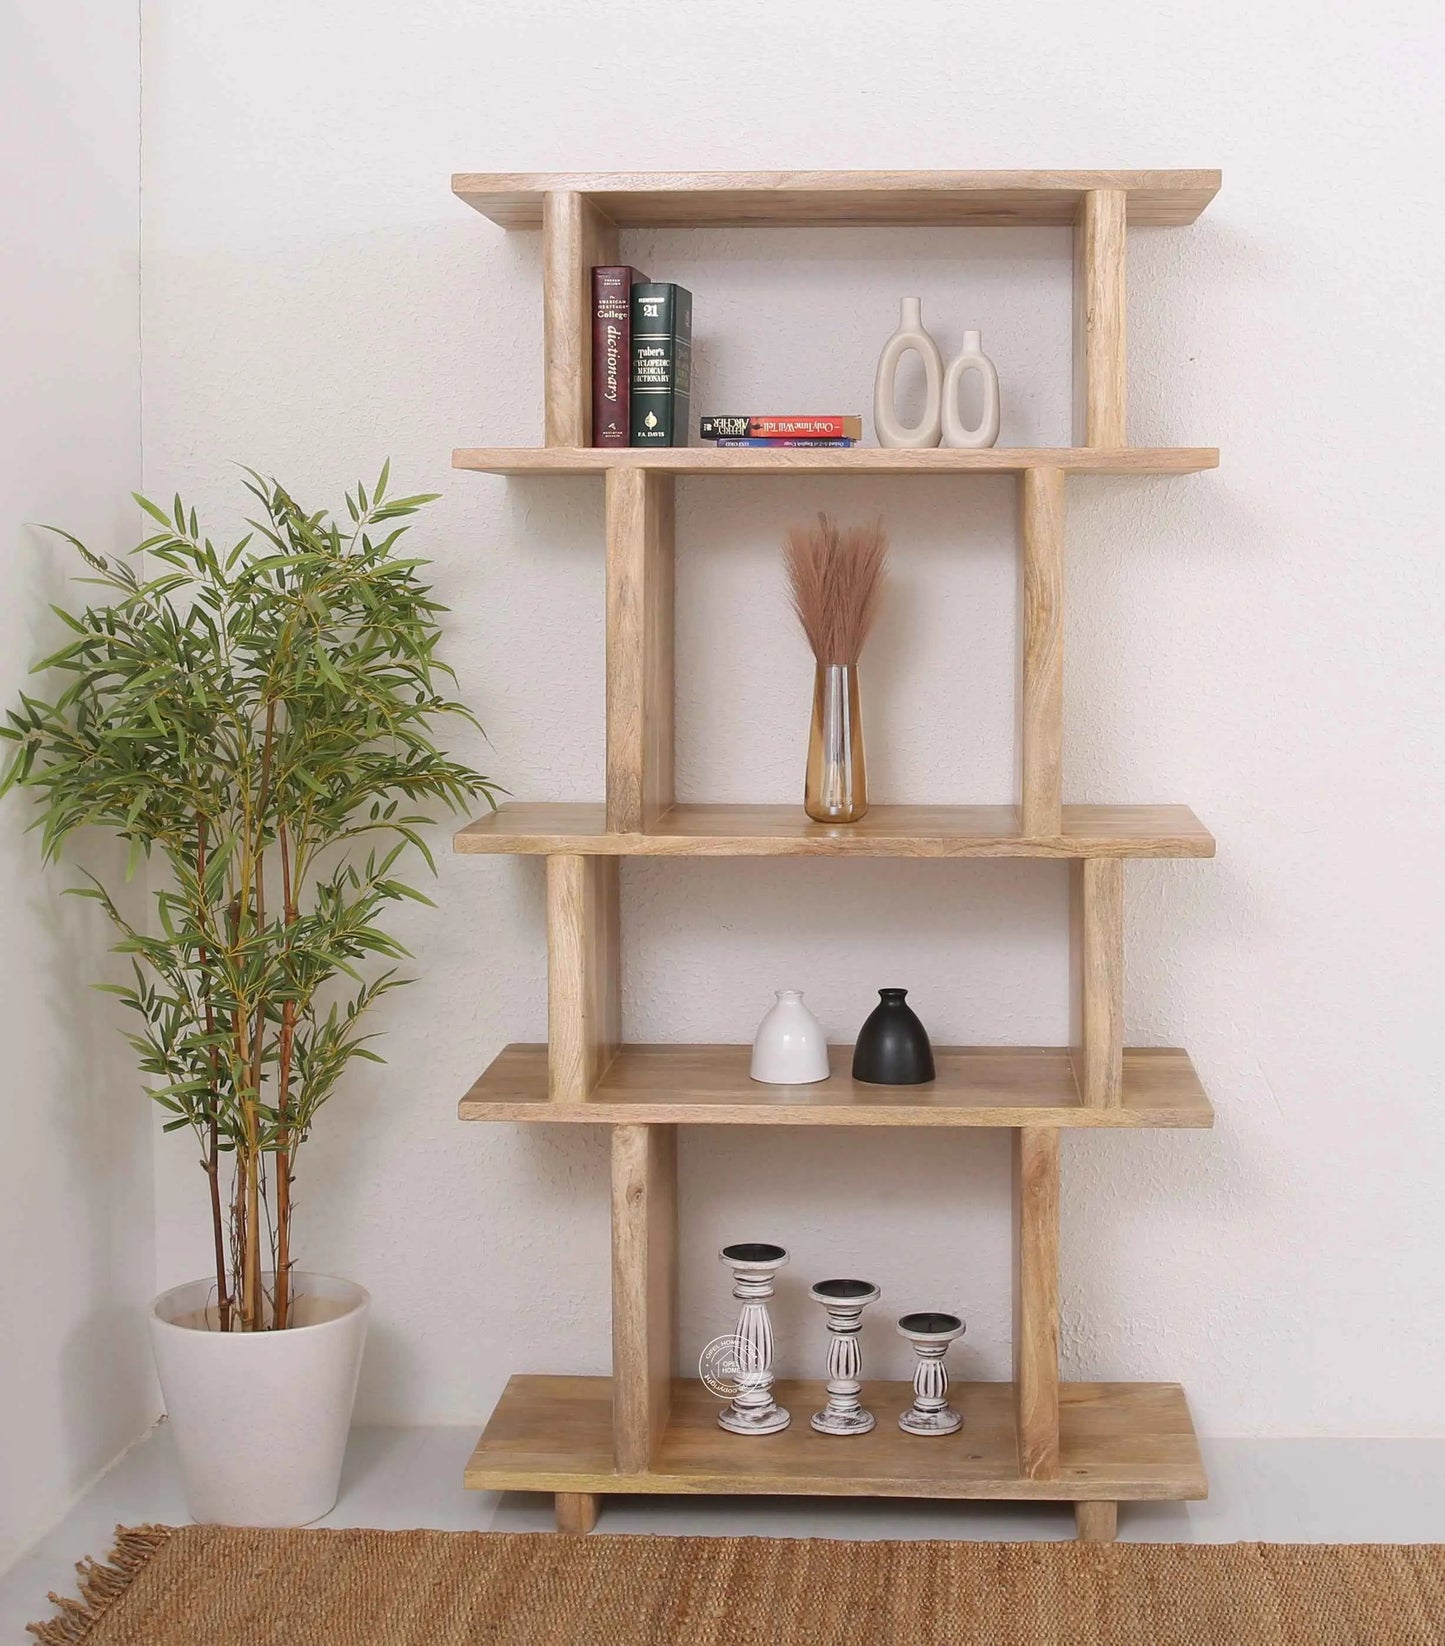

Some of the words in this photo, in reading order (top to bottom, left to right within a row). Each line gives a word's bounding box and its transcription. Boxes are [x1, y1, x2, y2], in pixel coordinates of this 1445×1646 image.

[597, 310, 627, 320] College
[643, 305, 659, 317] 21
[637, 346, 665, 359] Taber's
[712, 418, 750, 430] ARCHER
[763, 422, 778, 433] Tell
[778, 422, 795, 433] Will
[794, 422, 815, 433] Time
[813, 421, 834, 433] Only
